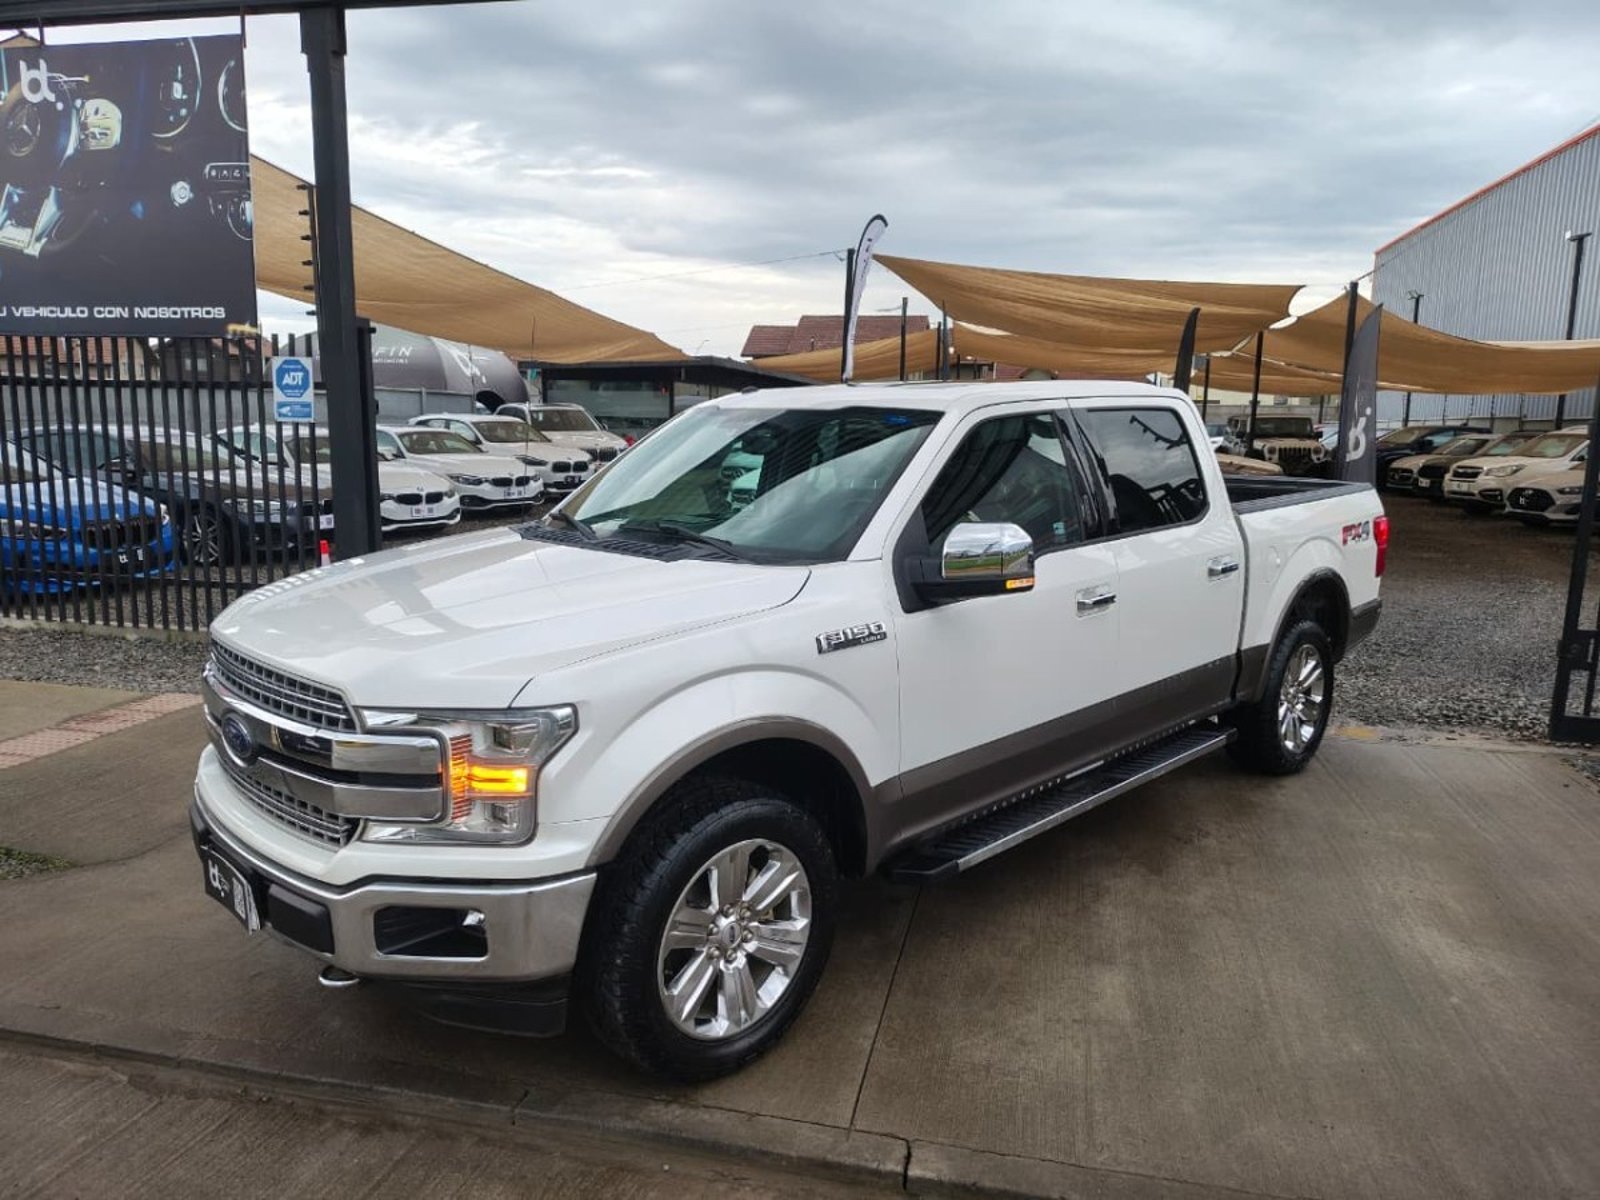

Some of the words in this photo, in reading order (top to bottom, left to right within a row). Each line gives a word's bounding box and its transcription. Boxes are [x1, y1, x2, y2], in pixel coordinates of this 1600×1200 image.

[11, 305, 89, 318] VEHICULO
[93, 306, 129, 319] CON
[134, 306, 226, 319] NOSOTROS
[282, 371, 304, 386] ADT
